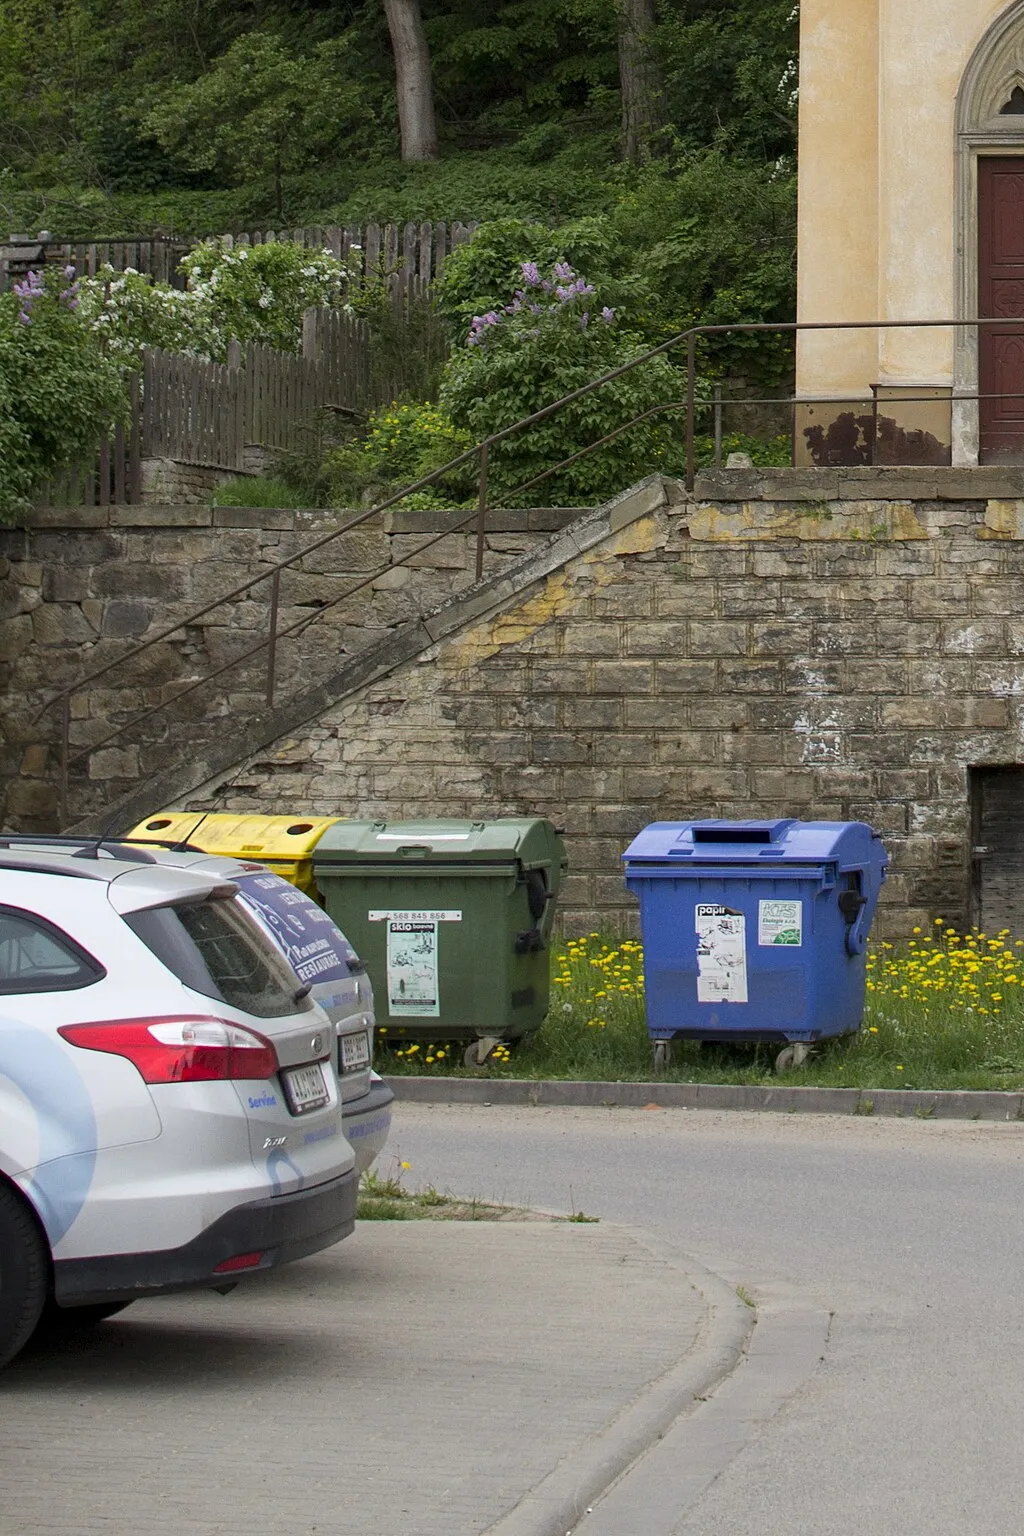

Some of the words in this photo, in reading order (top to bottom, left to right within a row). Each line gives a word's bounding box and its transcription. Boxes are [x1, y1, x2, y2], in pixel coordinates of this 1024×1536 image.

[393, 912, 409, 920] 568
[411, 912, 427, 920] 845
[430, 912, 446, 920] 856
[763, 903, 797, 919] KTS
[391, 923, 412, 931] sklo
[297, 953, 341, 981] RESTAURACE
